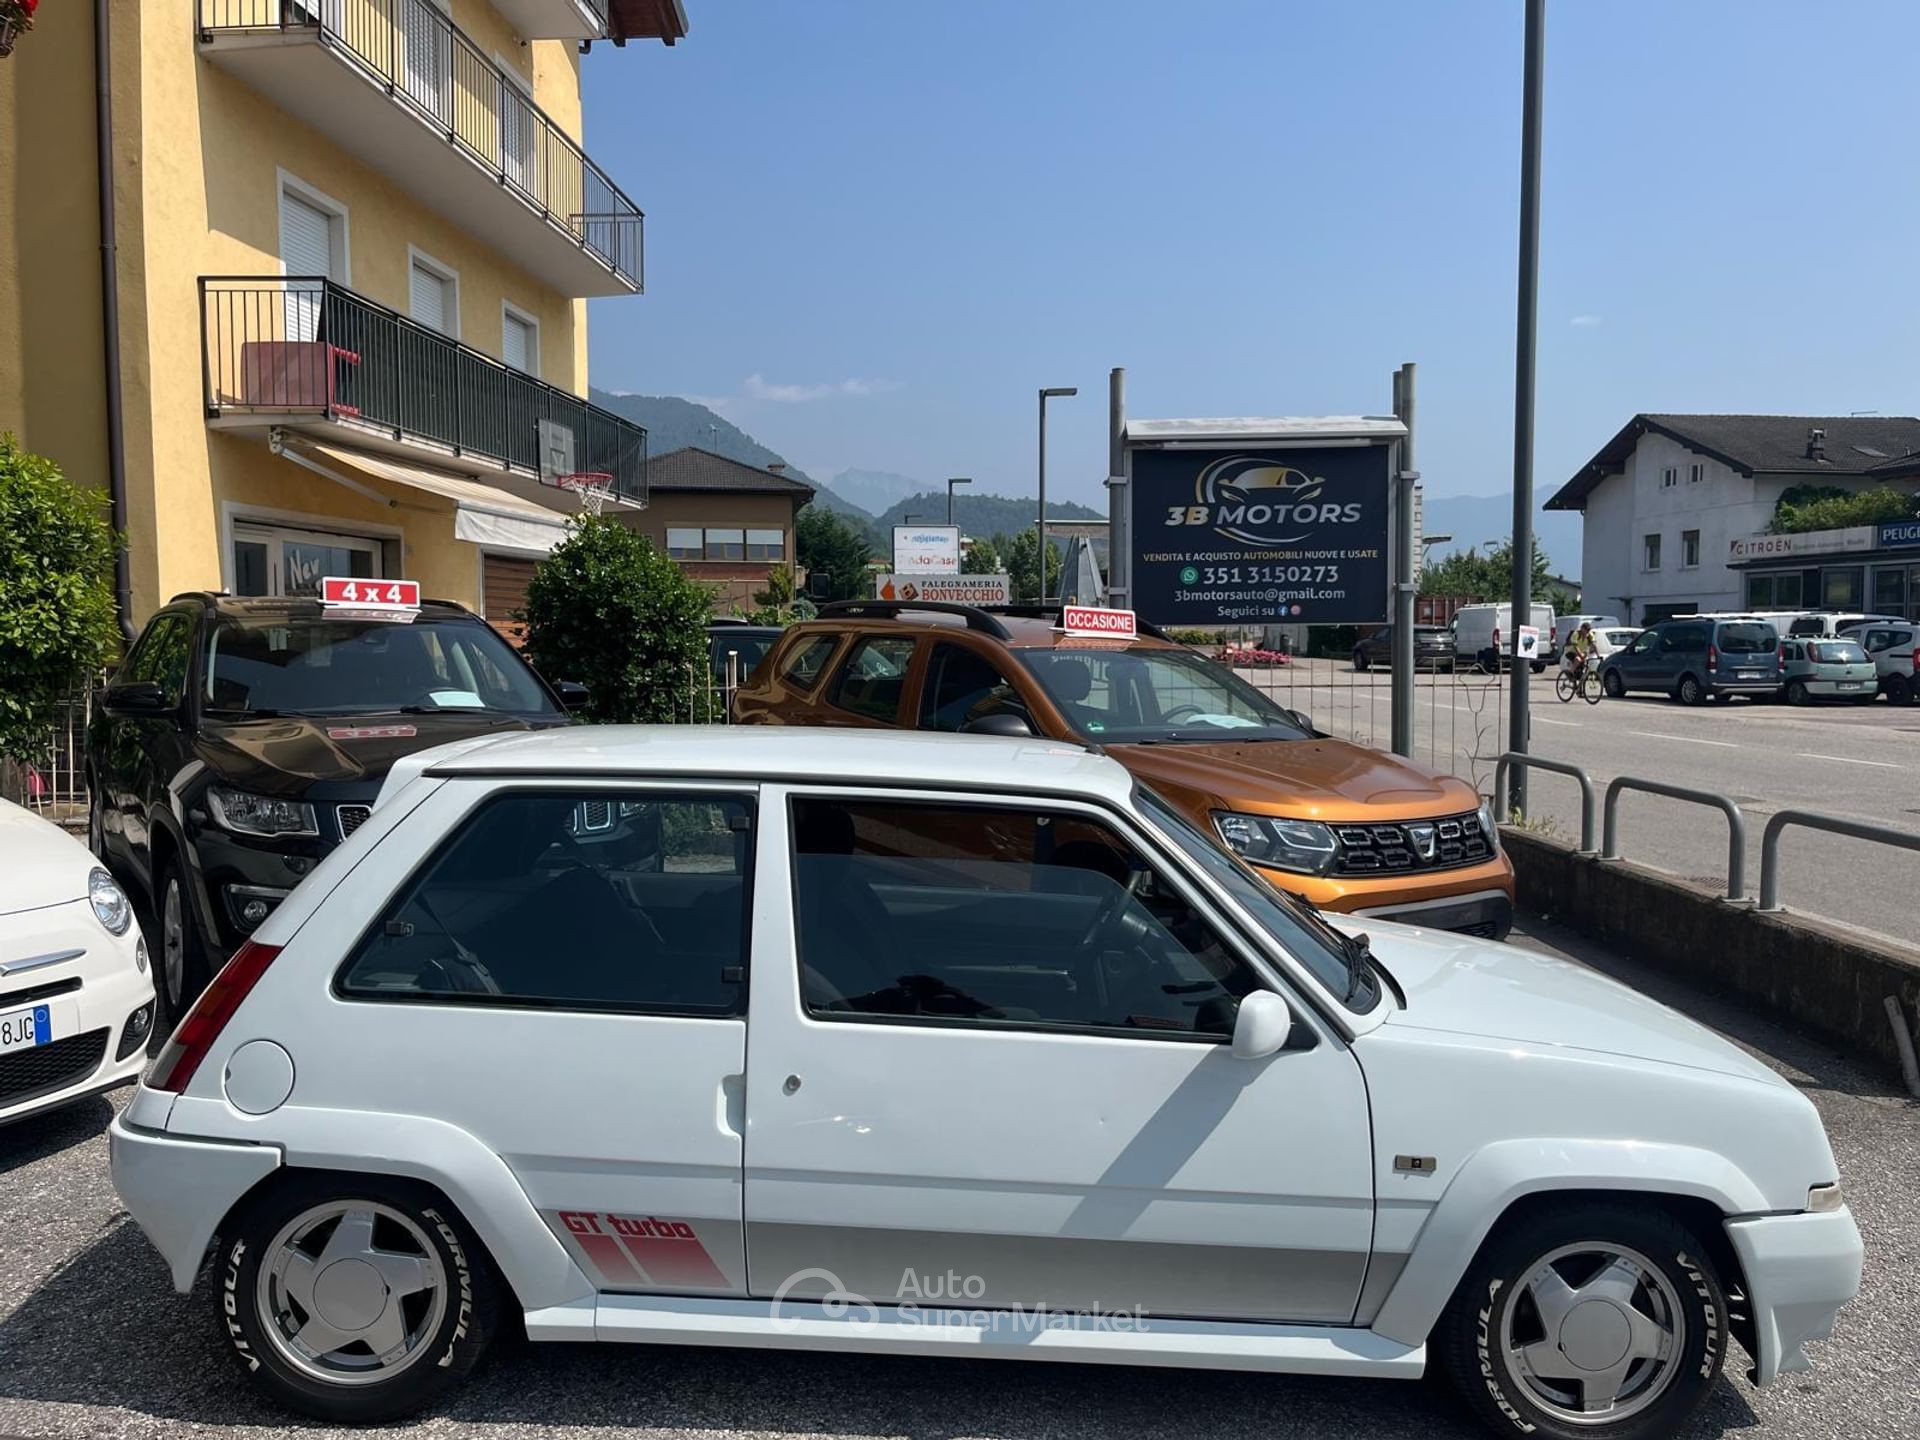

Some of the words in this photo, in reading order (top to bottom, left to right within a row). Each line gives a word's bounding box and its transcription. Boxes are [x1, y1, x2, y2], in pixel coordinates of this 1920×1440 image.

[1164, 506, 1210, 525] 3B
[1216, 503, 1362, 525] MOTORS
[1736, 538, 1792, 555] CITROËN
[1143, 553, 1183, 561] VENDITA
[1185, 553, 1192, 561] E
[1193, 552, 1241, 561] ACQUISTO
[1243, 551, 1303, 560] AUTOMOBILI
[1305, 551, 1338, 559] NUOVE
[1348, 550, 1378, 558] USATE
[1203, 567, 1241, 584] 351
[1247, 566, 1339, 583] 3150273
[342, 582, 358, 600] 4
[386, 584, 402, 603] 4
[921, 580, 1003, 588] FALEGNAMERIA
[922, 589, 1004, 601] BONVECCHIO
[1174, 588, 1345, 603] 3bmotorsauto@gmail.com
[1217, 605, 1260, 619] Seguici
[1261, 608, 1275, 616] su
[1067, 612, 1132, 631] OCCASIONE
[559, 1211, 602, 1234] GT
[606, 1213, 696, 1239] turbo
